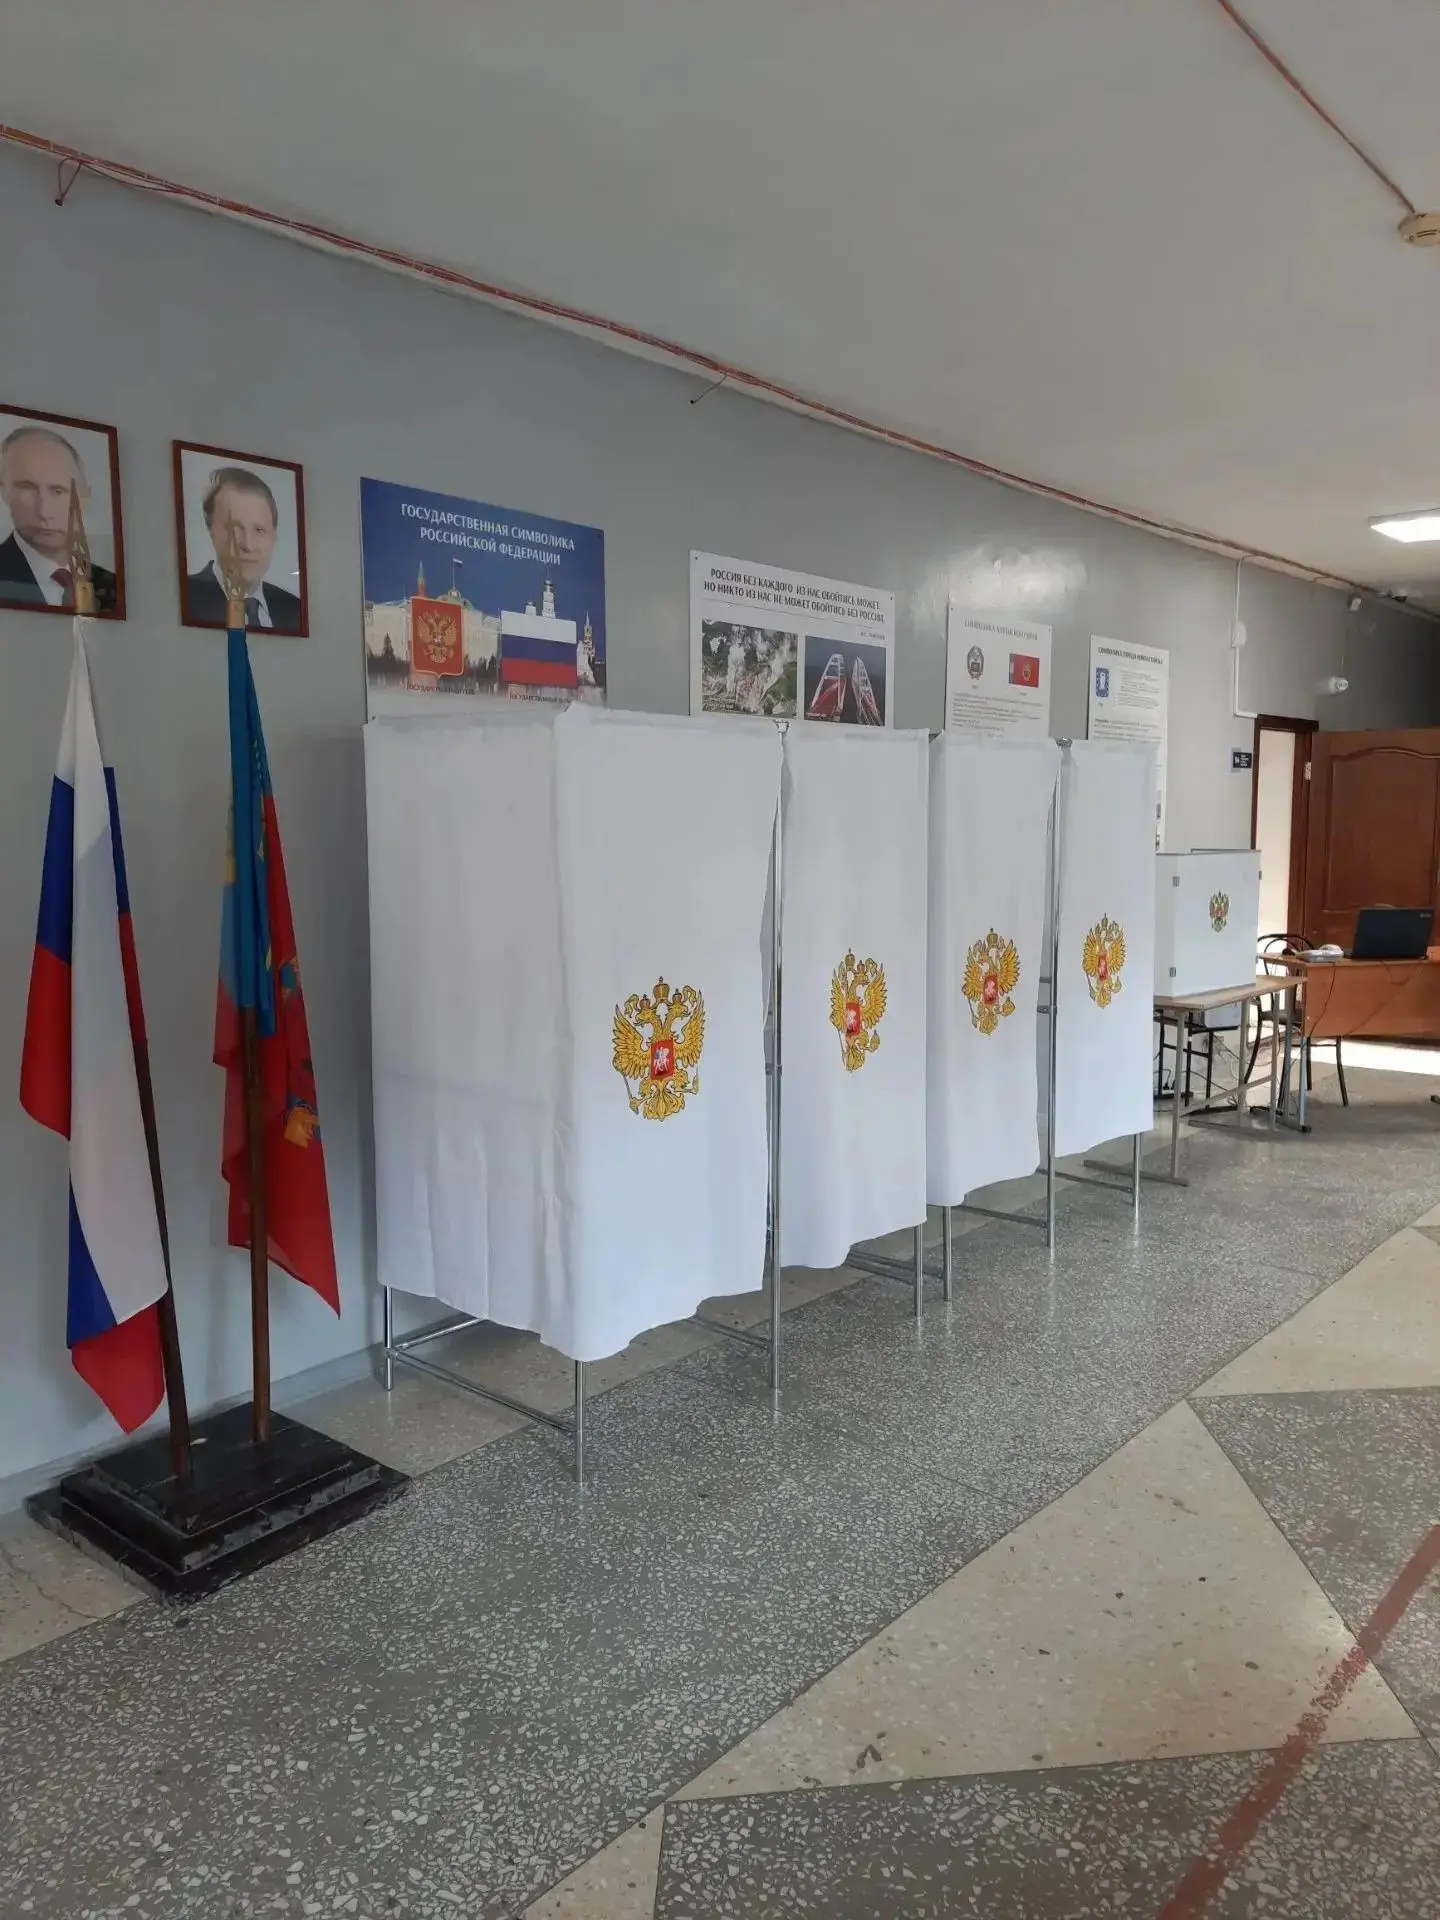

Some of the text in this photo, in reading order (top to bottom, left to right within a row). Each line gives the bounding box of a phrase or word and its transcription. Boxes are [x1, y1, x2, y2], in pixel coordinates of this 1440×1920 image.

[401, 503, 575, 551] ГОСУДАРСТВЕННАЯ СИМВОЛИКА
[420, 527, 560, 565] РОССИЙСКОЙ ФЕДЕРАЦИИ
[704, 580, 716, 592] НО
[717, 584, 744, 597] НИКТО
[746, 588, 756, 600] ИЗ
[757, 590, 772, 602] НАС
[773, 594, 783, 605] НЕ
[784, 596, 810, 609] МОЖЕТ
[811, 601, 846, 617] ОБОЙТИСЬ
[847, 607, 859, 618] БЕЗ
[710, 568, 742, 583] РОССИЯ
[743, 574, 757, 586] БЕЗ
[758, 577, 793, 593] КАЖДОГО
[796, 584, 806, 596] ИЗ
[807, 586, 820, 599] НАС
[821, 588, 855, 606] ОБОЙТИСЬ
